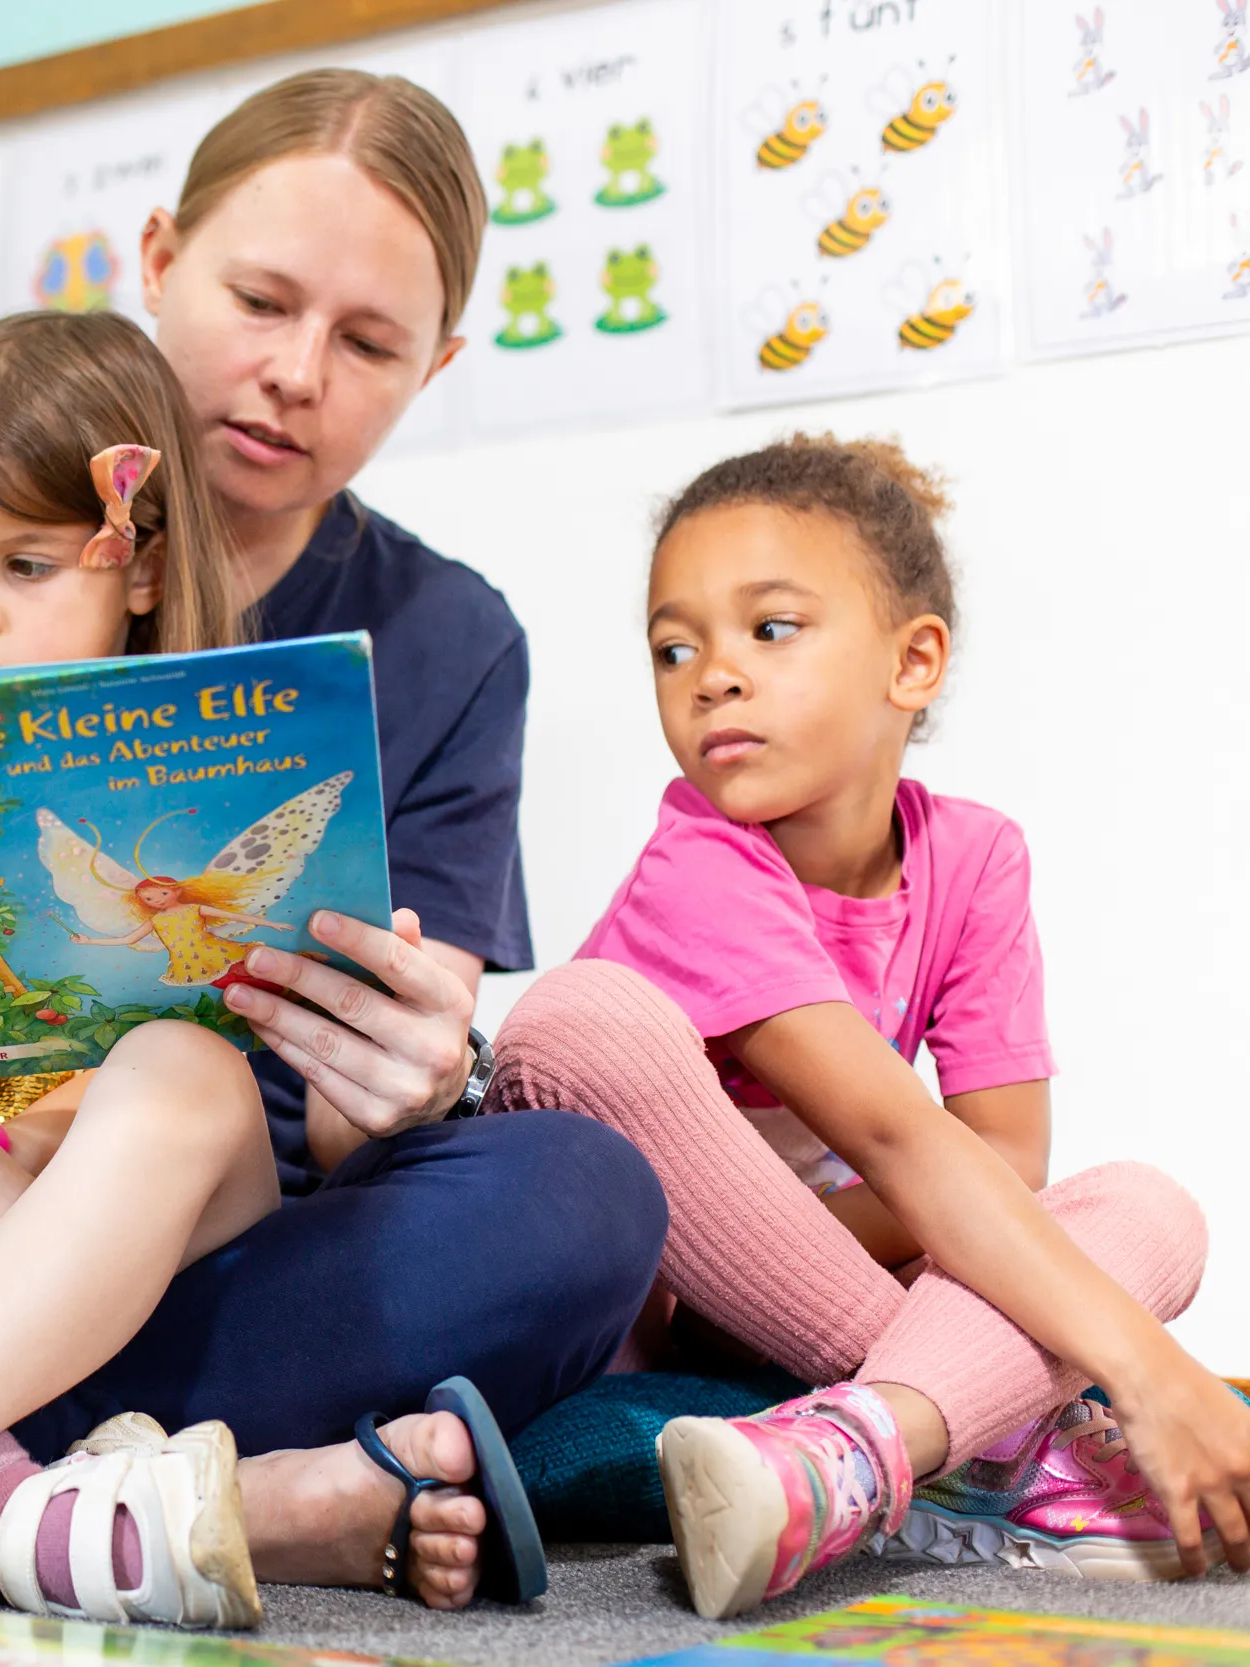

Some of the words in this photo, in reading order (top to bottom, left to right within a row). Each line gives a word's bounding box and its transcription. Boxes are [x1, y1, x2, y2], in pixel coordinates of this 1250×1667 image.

[18, 702, 177, 745] Kleine
[199, 680, 299, 721] Elfe
[6, 755, 52, 777] und
[60, 750, 100, 770] das
[109, 729, 271, 763] Abenteuer
[109, 774, 140, 791] im
[146, 754, 307, 787] Baumhaus
